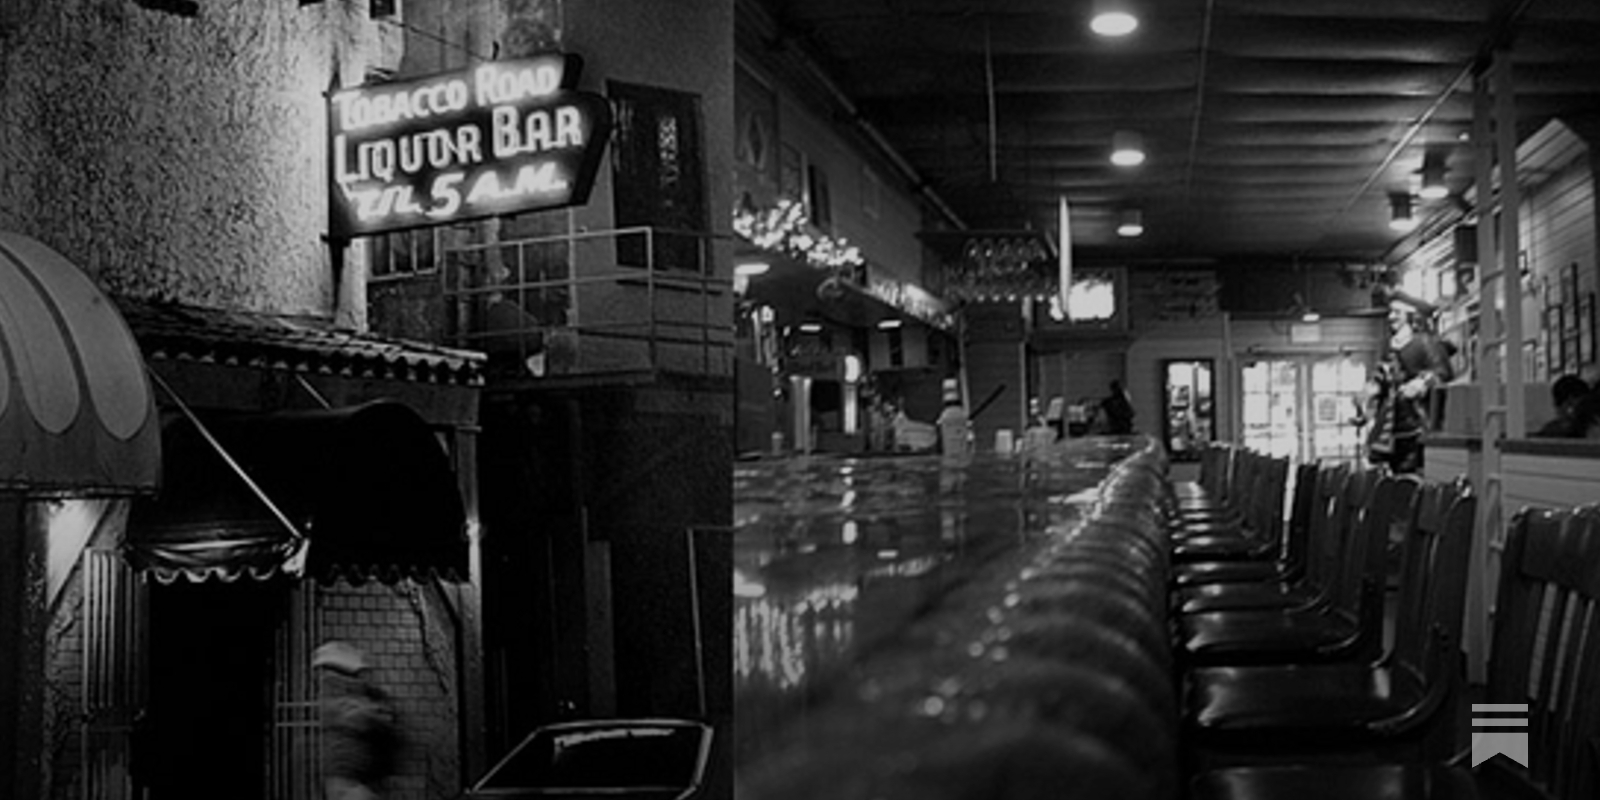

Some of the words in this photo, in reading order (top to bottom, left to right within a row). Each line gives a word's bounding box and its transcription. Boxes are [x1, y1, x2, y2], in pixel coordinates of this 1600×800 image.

[332, 81, 467, 131] TOBACCO
[476, 64, 556, 106] ROAD
[335, 125, 482, 182] LIQUOR
[493, 106, 583, 157] BAR
[425, 173, 464, 217] 5
[466, 162, 567, 203] A.M.
